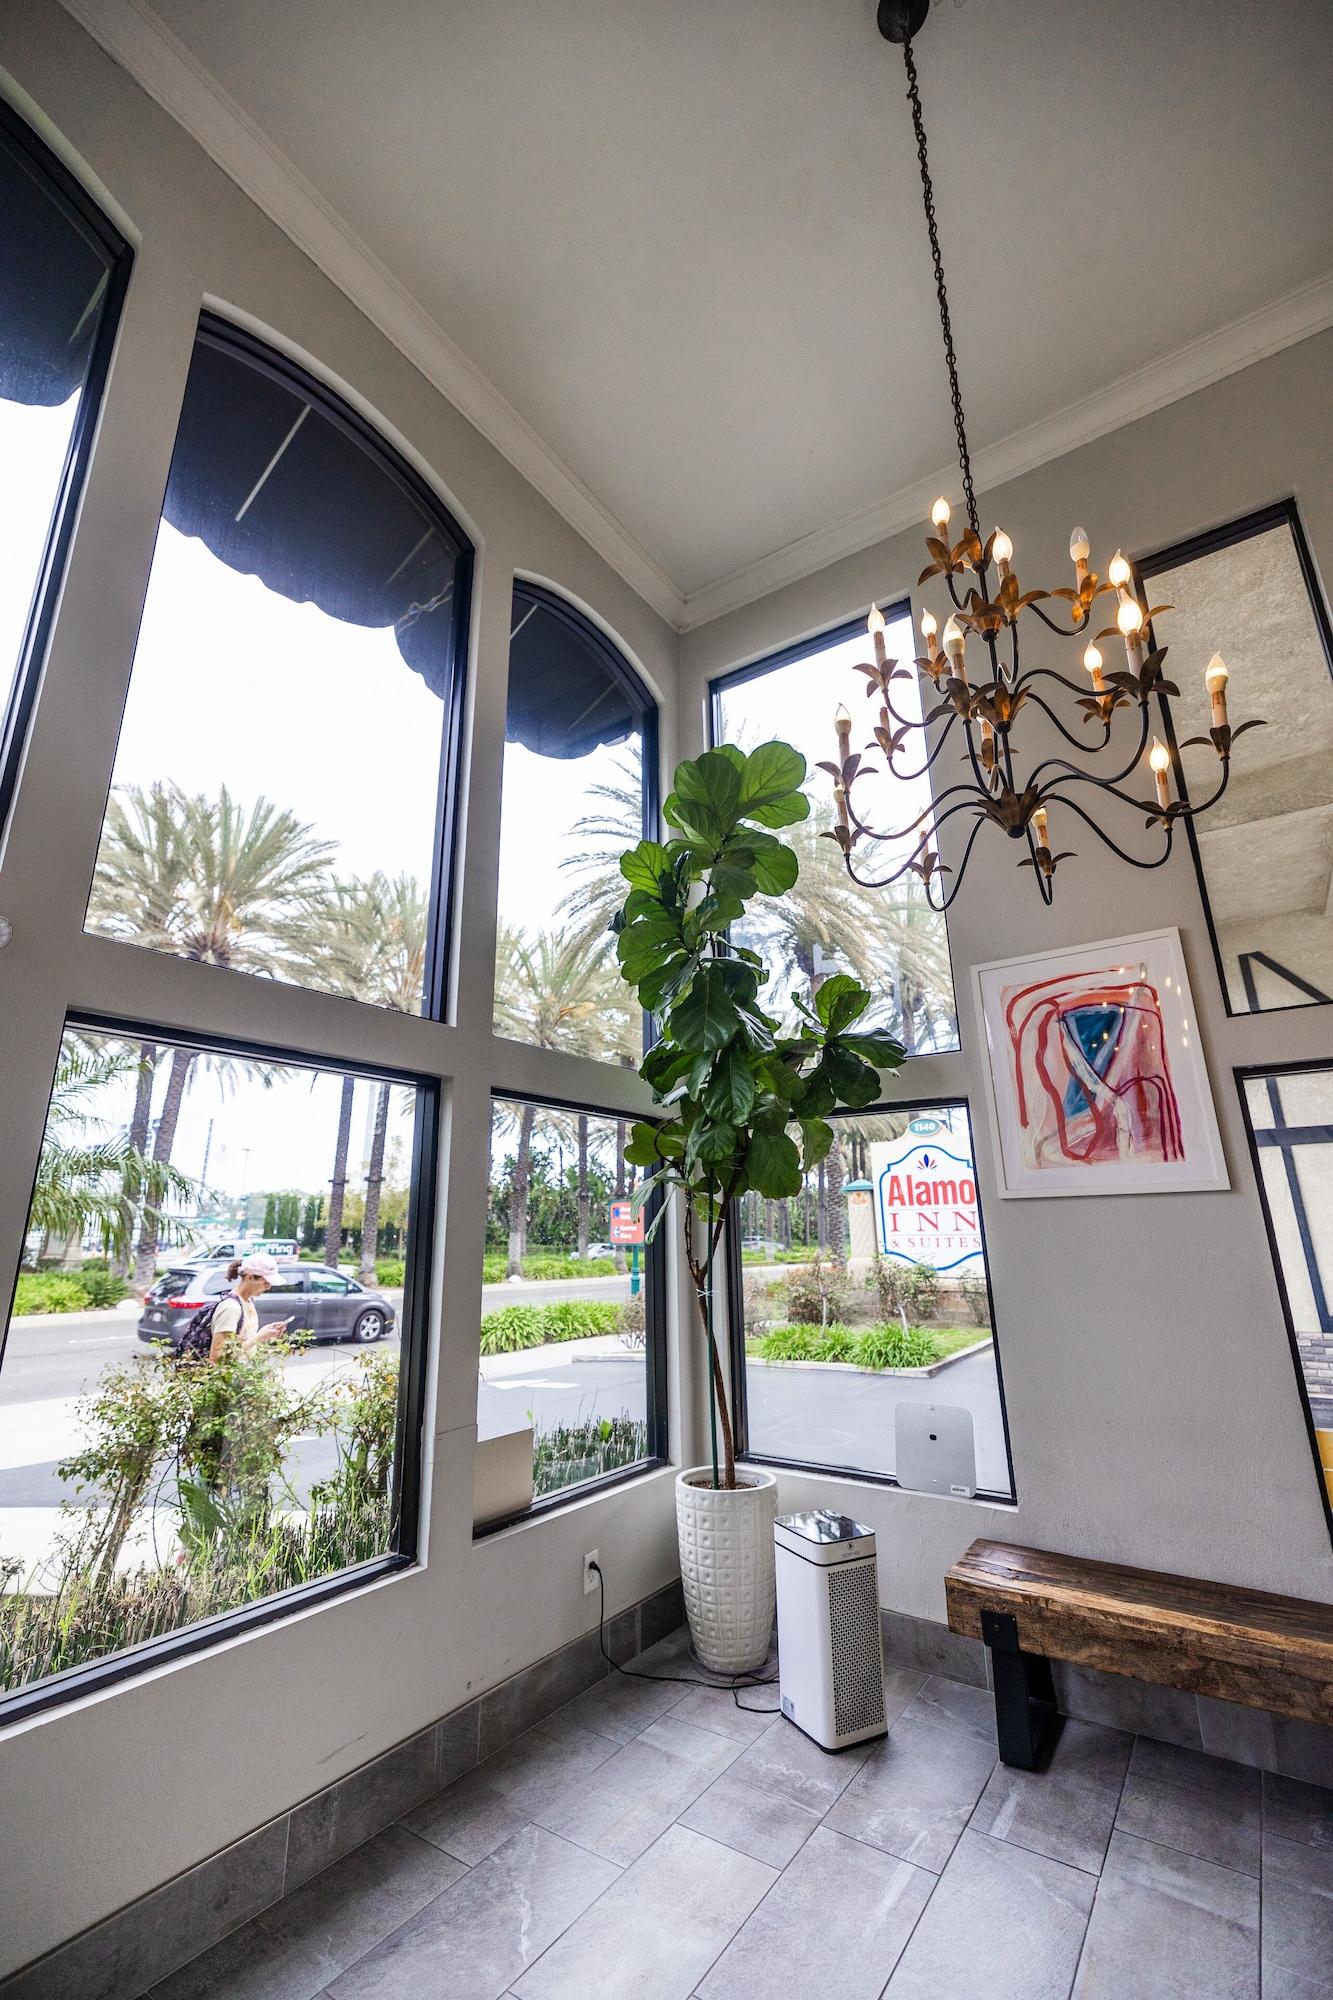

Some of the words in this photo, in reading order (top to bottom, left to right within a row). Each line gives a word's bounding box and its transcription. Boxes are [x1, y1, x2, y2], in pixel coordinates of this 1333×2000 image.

[914, 1122, 936, 1132] 1140
[888, 1174, 976, 1207] Alamo
[889, 1210, 977, 1233] INN
[891, 1239, 901, 1248] &
[907, 1237, 981, 1248] SUITES
